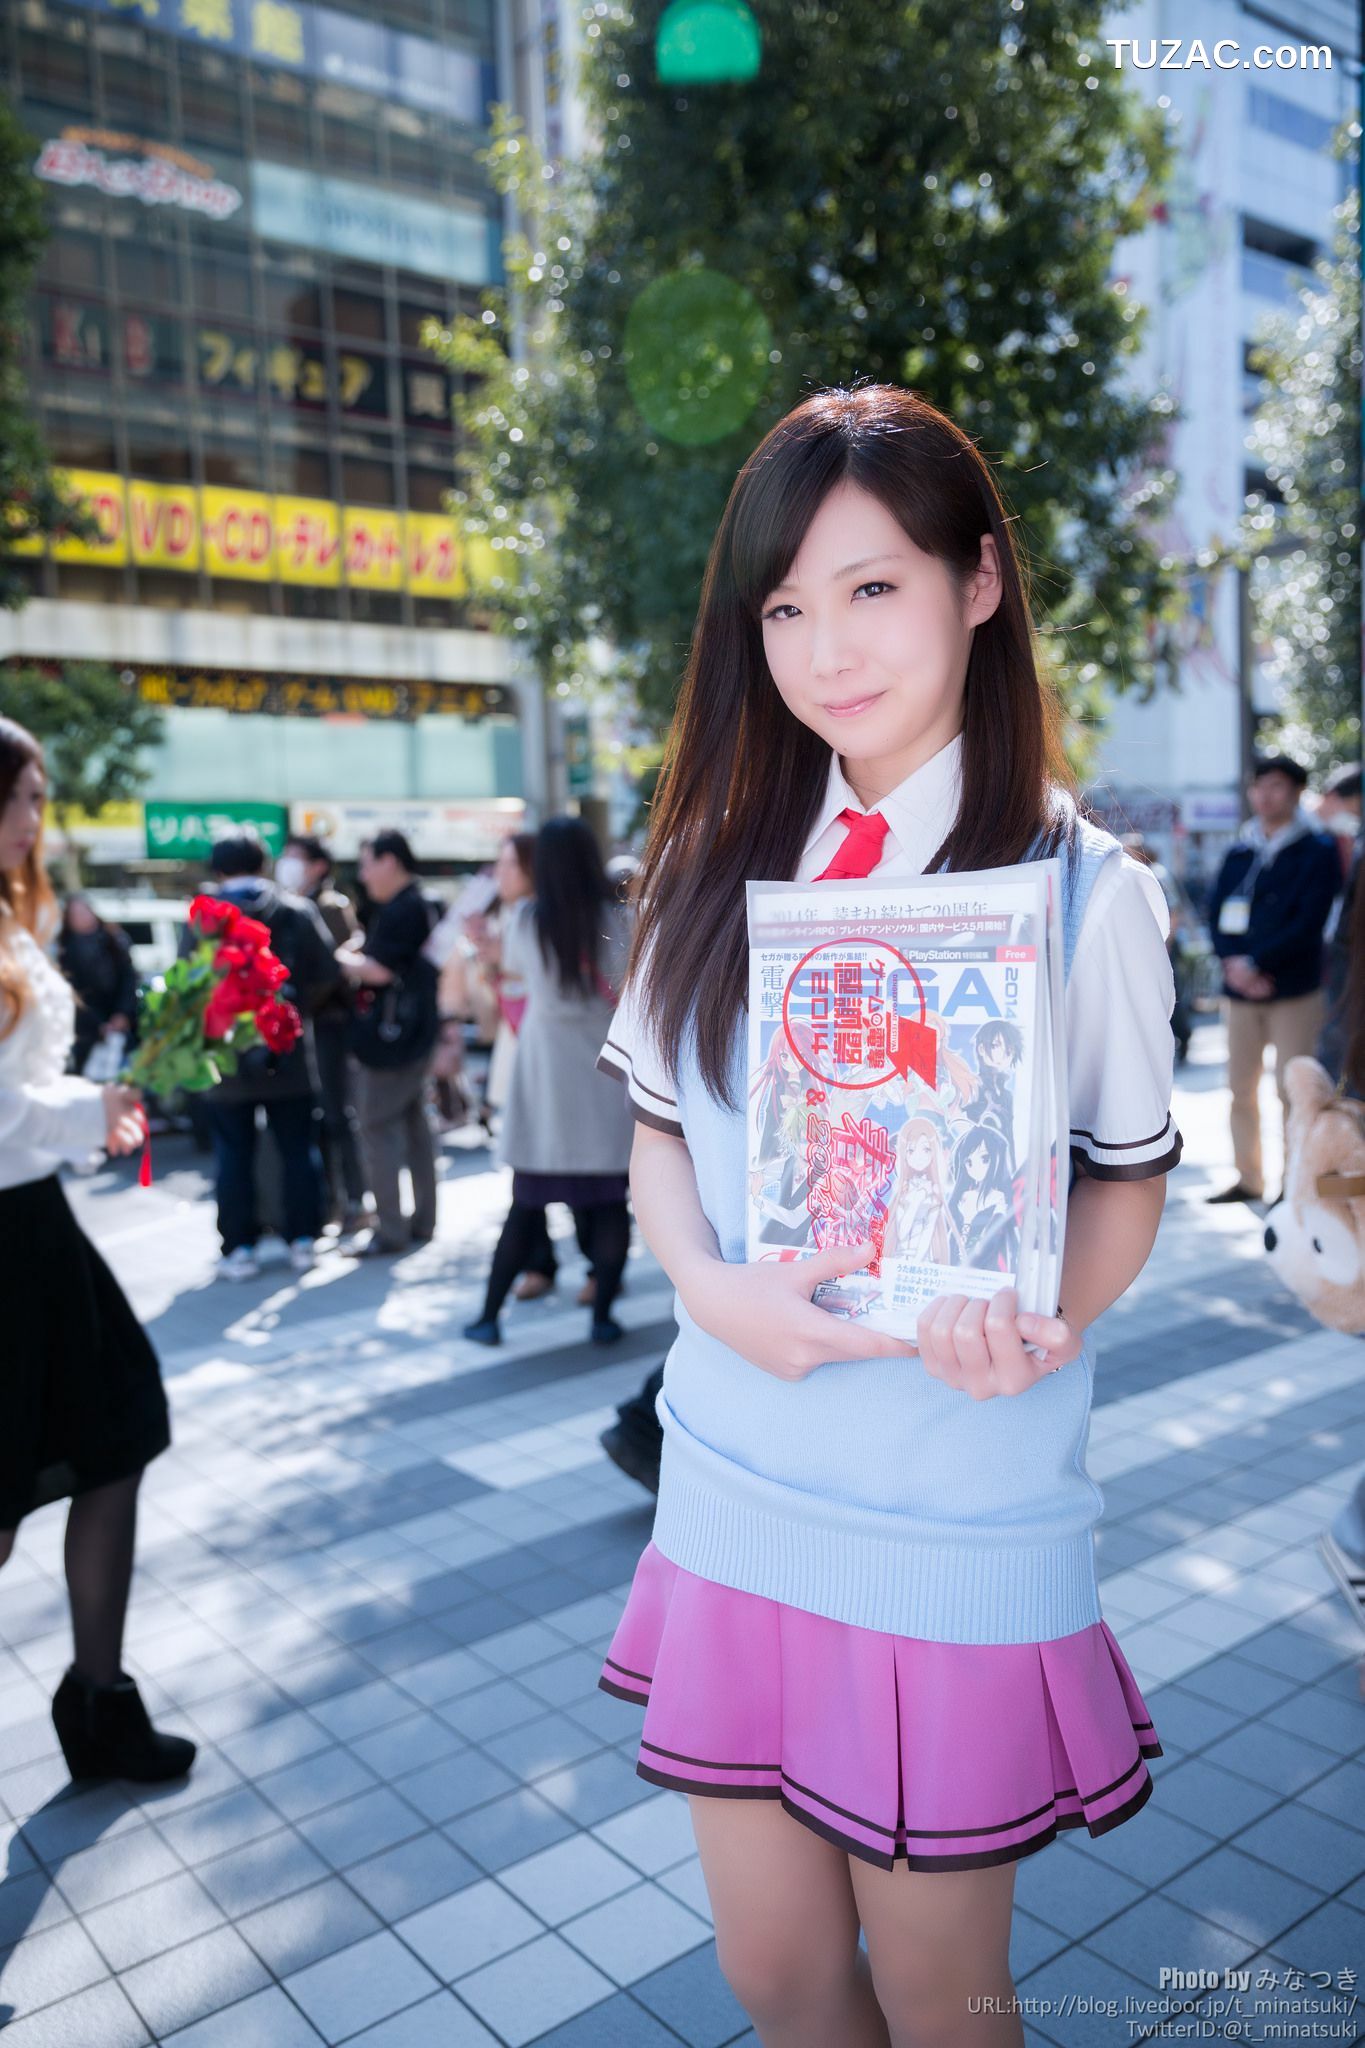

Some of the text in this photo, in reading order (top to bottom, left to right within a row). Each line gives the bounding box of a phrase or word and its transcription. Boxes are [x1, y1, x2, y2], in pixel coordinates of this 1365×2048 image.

[908, 950, 962, 962] PlayStation
[1005, 950, 1026, 960] Free
[760, 964, 785, 1018] 電撃
[788, 968, 1002, 1017] SEGA
[811, 971, 829, 1055] 2014
[1004, 967, 1019, 1020] 2014
